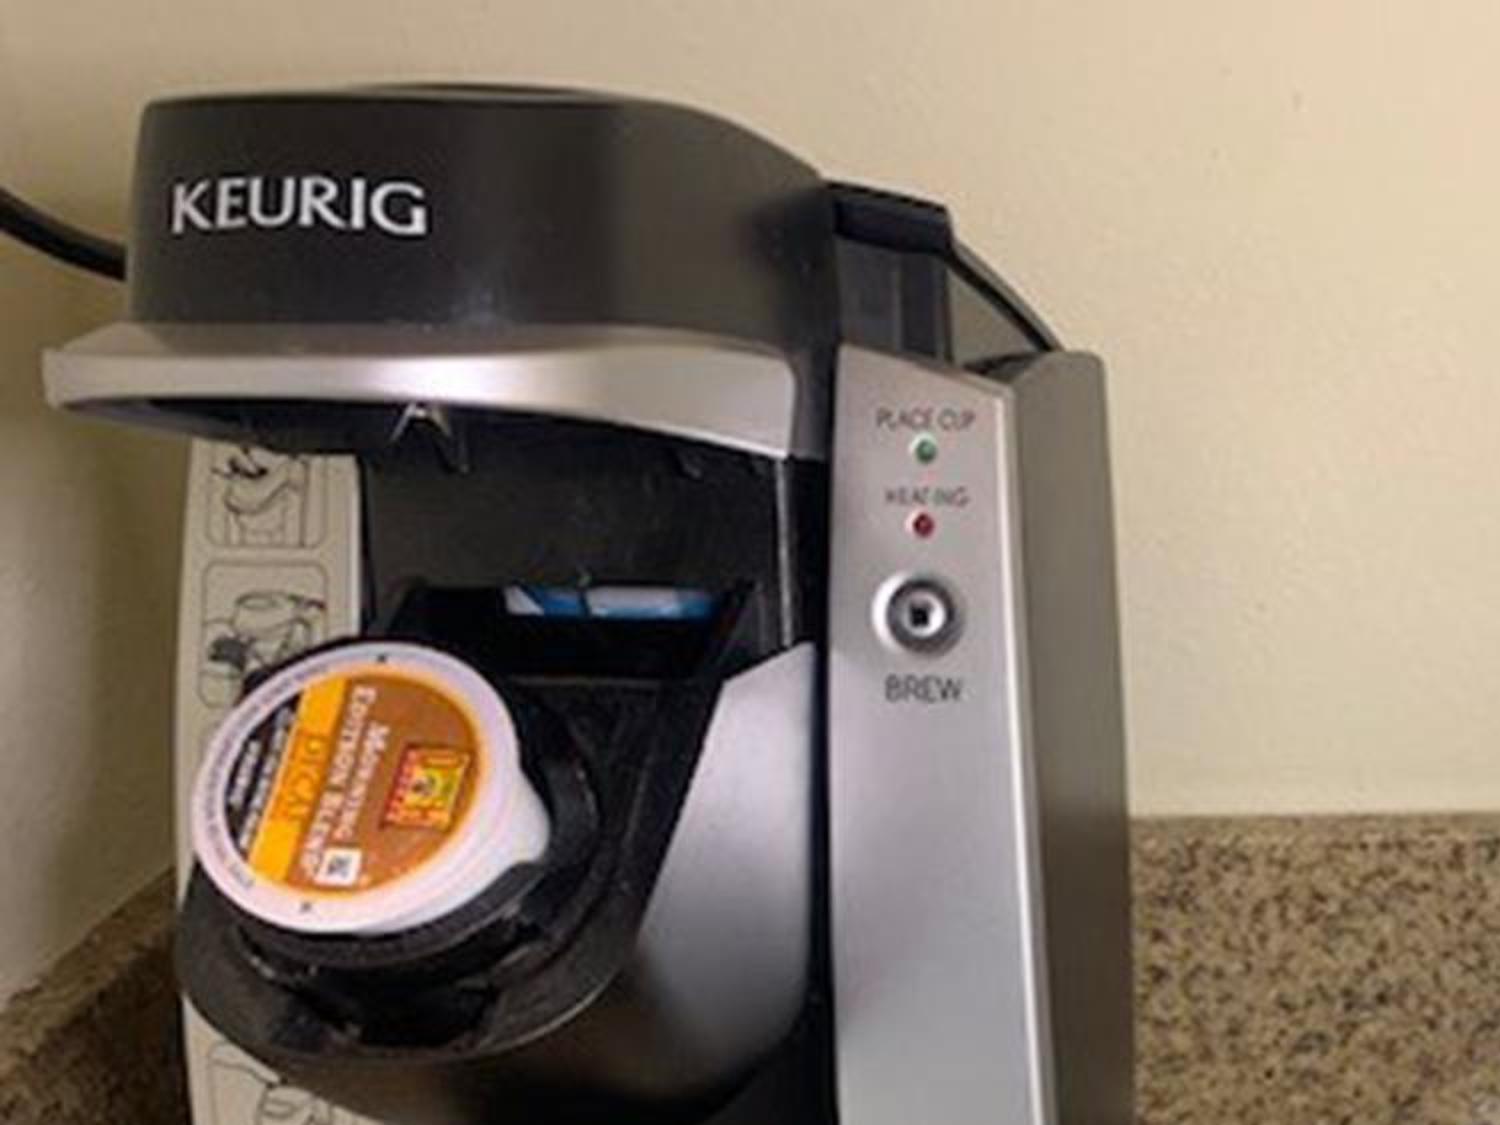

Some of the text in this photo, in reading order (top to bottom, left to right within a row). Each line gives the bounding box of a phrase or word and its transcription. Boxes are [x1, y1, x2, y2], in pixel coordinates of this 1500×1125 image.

[171, 174, 428, 236] KEURIG
[875, 406, 977, 432] PLACE CUP
[884, 485, 972, 508] HEATING
[884, 673, 965, 703] BREW
